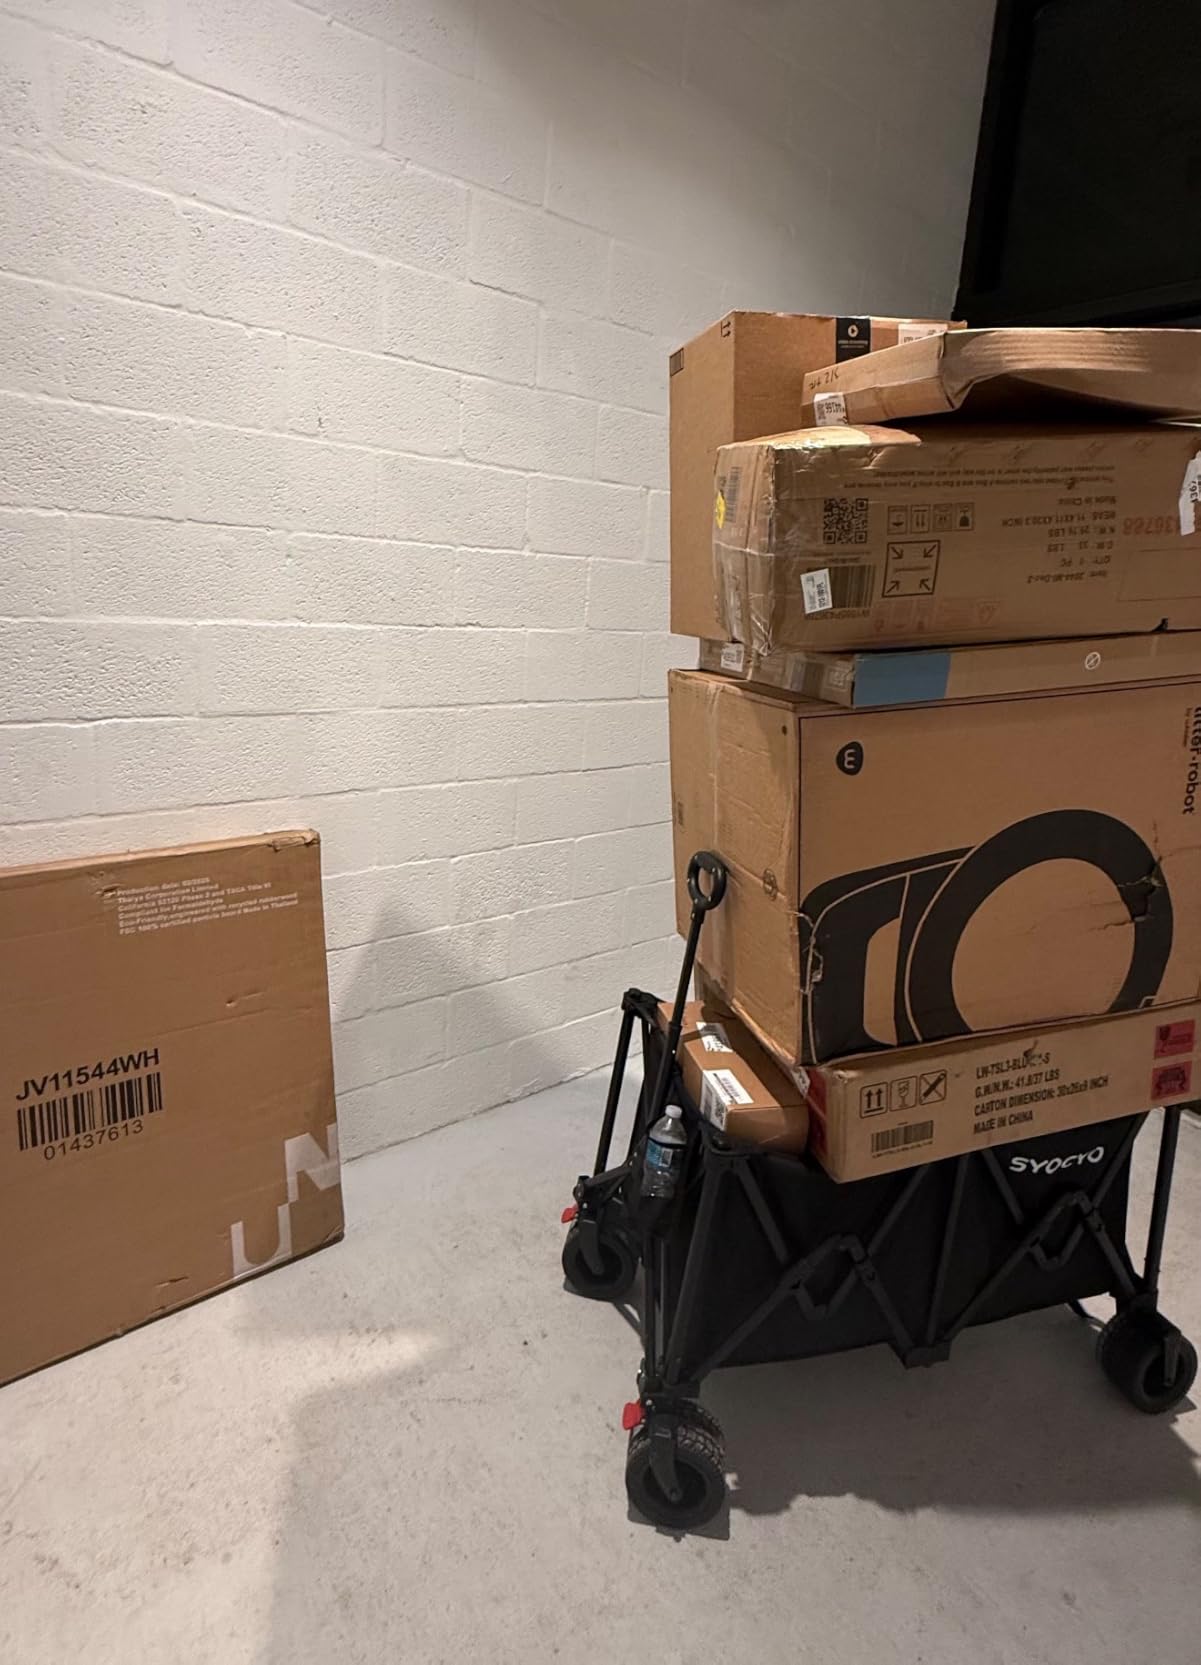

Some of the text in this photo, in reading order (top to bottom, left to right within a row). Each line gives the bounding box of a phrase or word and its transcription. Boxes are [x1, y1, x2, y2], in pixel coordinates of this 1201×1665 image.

[16, 1048, 160, 1101] JV11544WH
[1044, 1069, 1061, 1082] LBS
[974, 1098, 1007, 1116] CARTON
[1089, 1075, 1109, 1090] INCH
[44, 1119, 144, 1161] 01437613
[974, 1110, 1034, 1134] MADE IN CHINA
